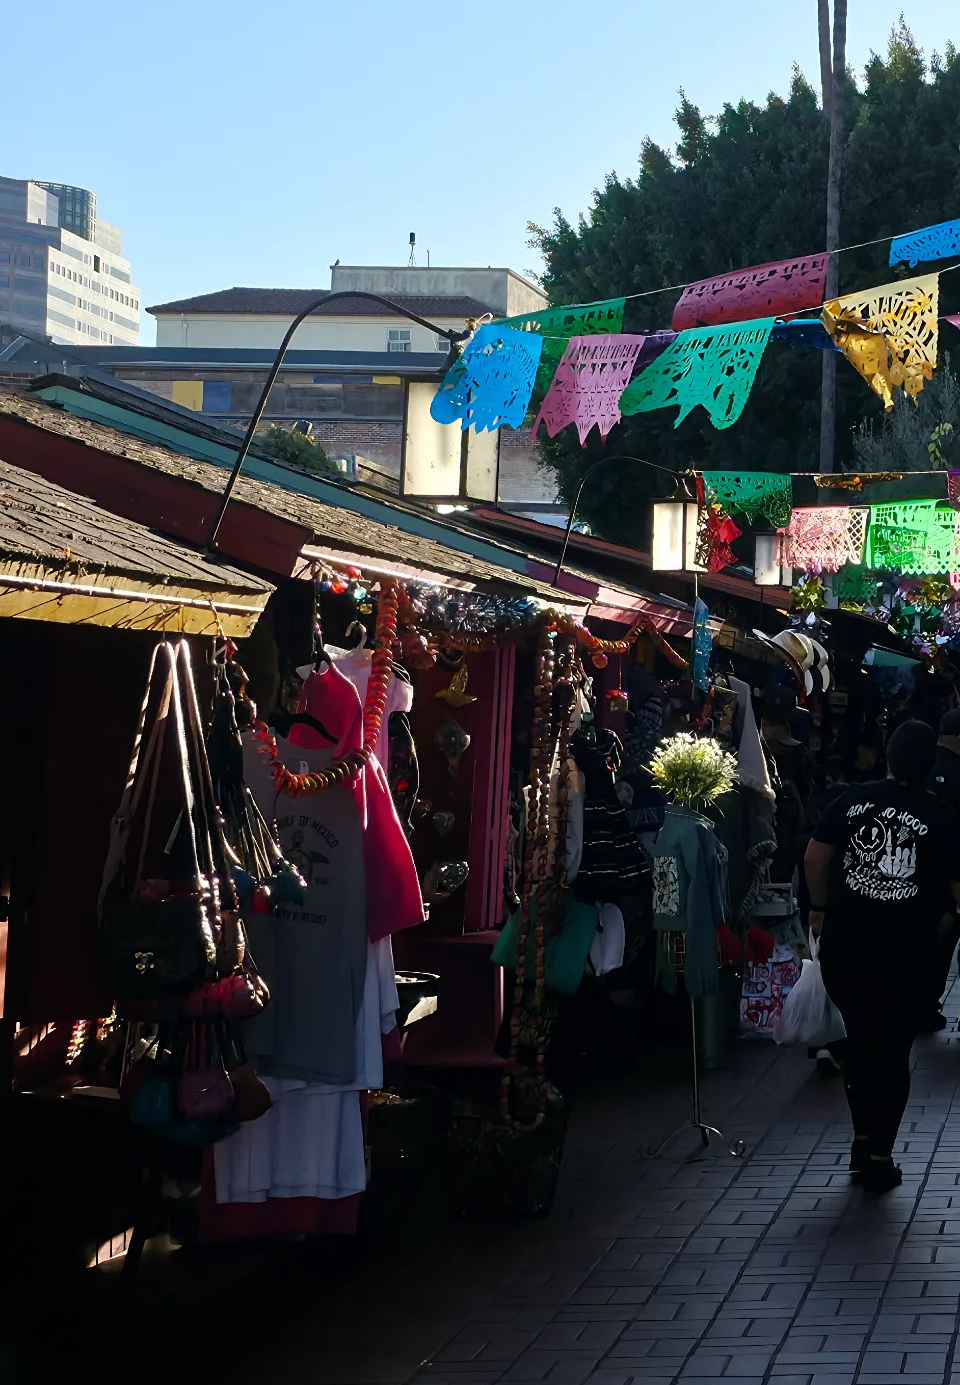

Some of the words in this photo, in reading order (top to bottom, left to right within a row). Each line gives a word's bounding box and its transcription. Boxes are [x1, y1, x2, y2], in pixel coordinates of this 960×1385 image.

[299, 815, 310, 826] OF
[312, 819, 339, 849] MEXICO
[897, 811, 928, 836] HOOD
[846, 875, 919, 901] MOTHERHOOD
